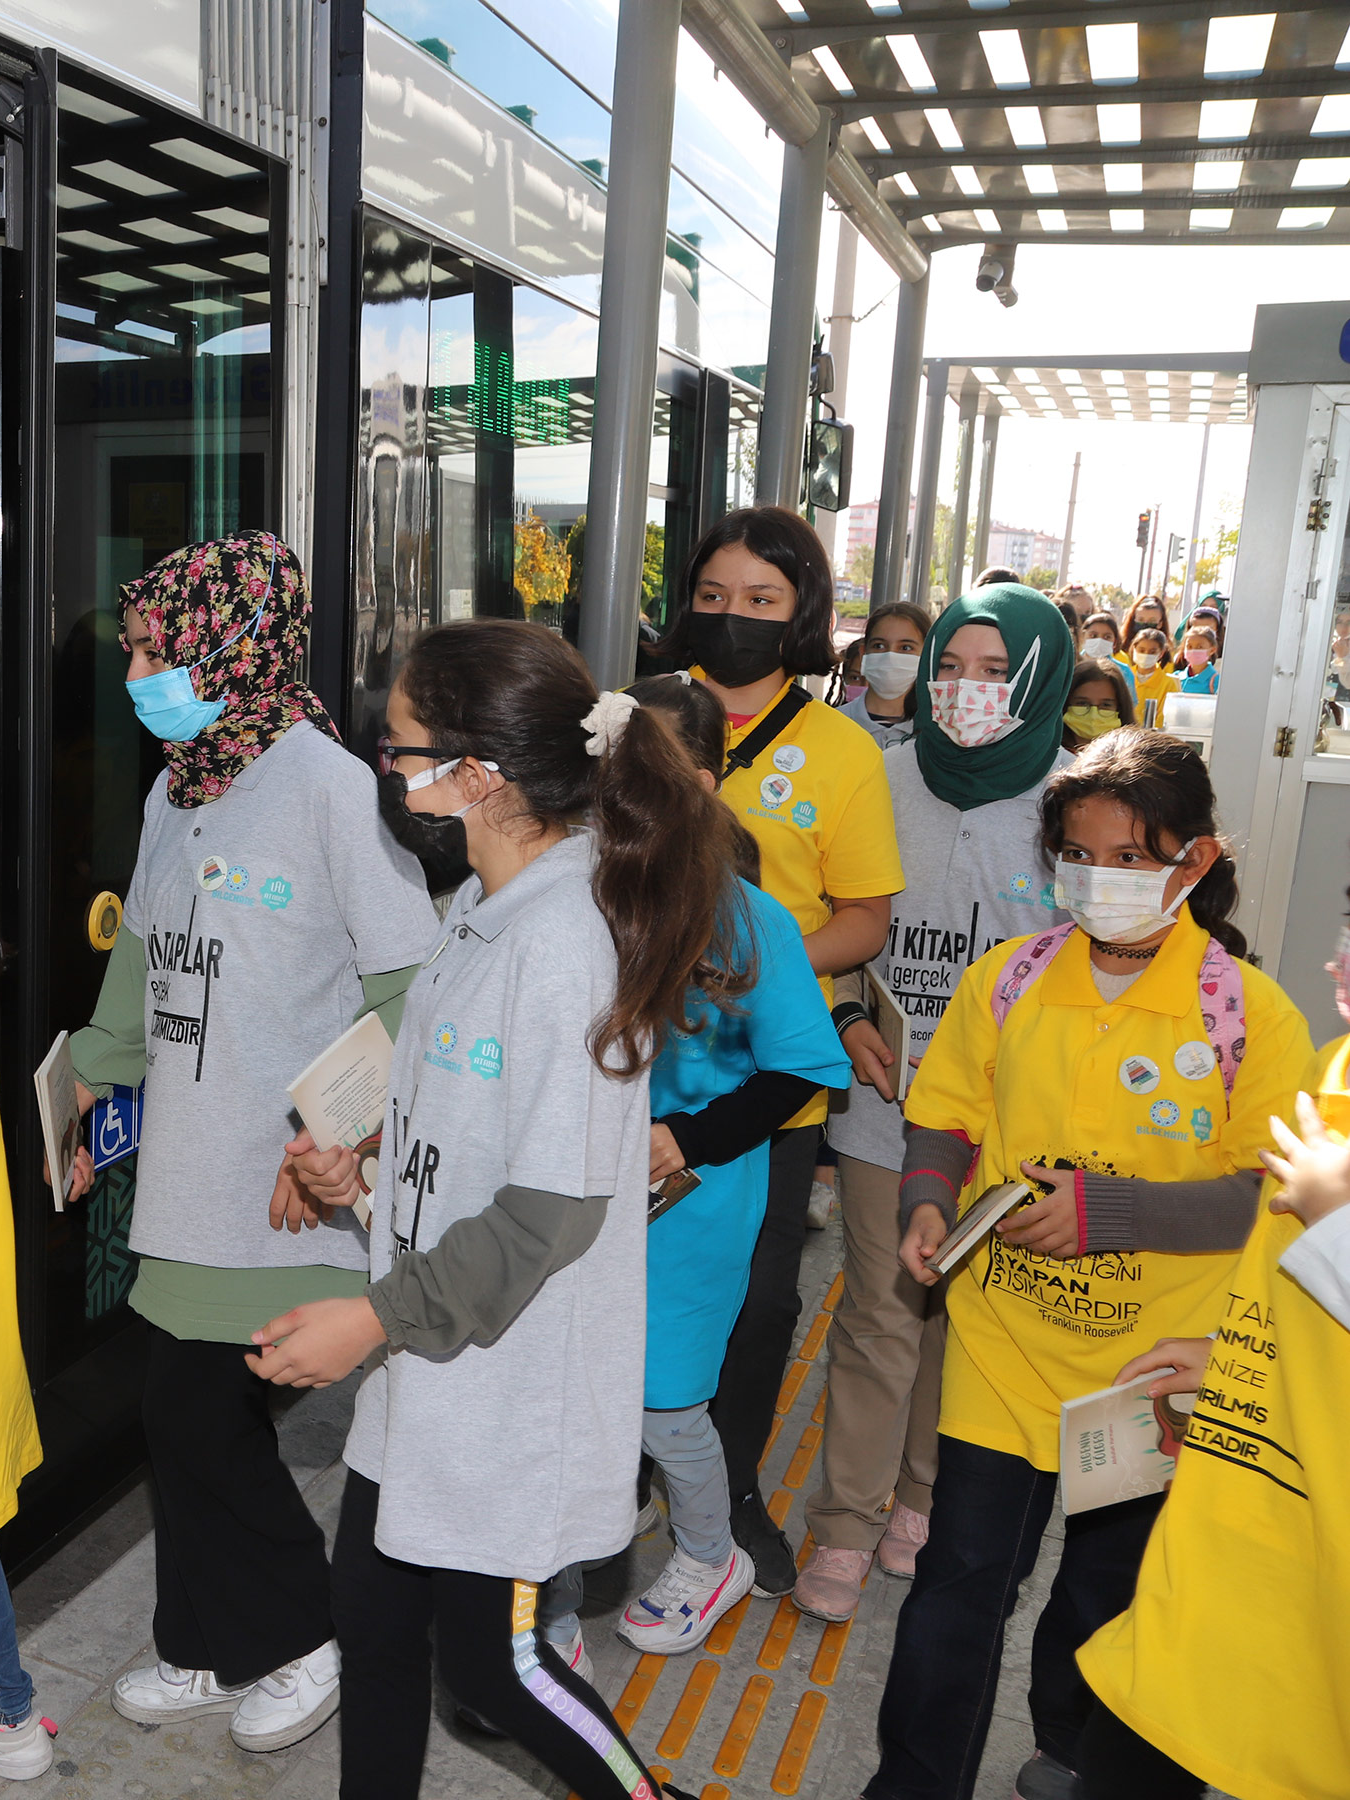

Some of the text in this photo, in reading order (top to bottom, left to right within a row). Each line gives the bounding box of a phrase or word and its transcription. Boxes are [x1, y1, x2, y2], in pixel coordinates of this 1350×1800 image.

[893, 965, 952, 993] gerçek
[1006, 1254, 1090, 1295] YAPAN
[1006, 1269, 1142, 1320] IŞIKLARDIR
[536, 1675, 576, 1721] YORK
